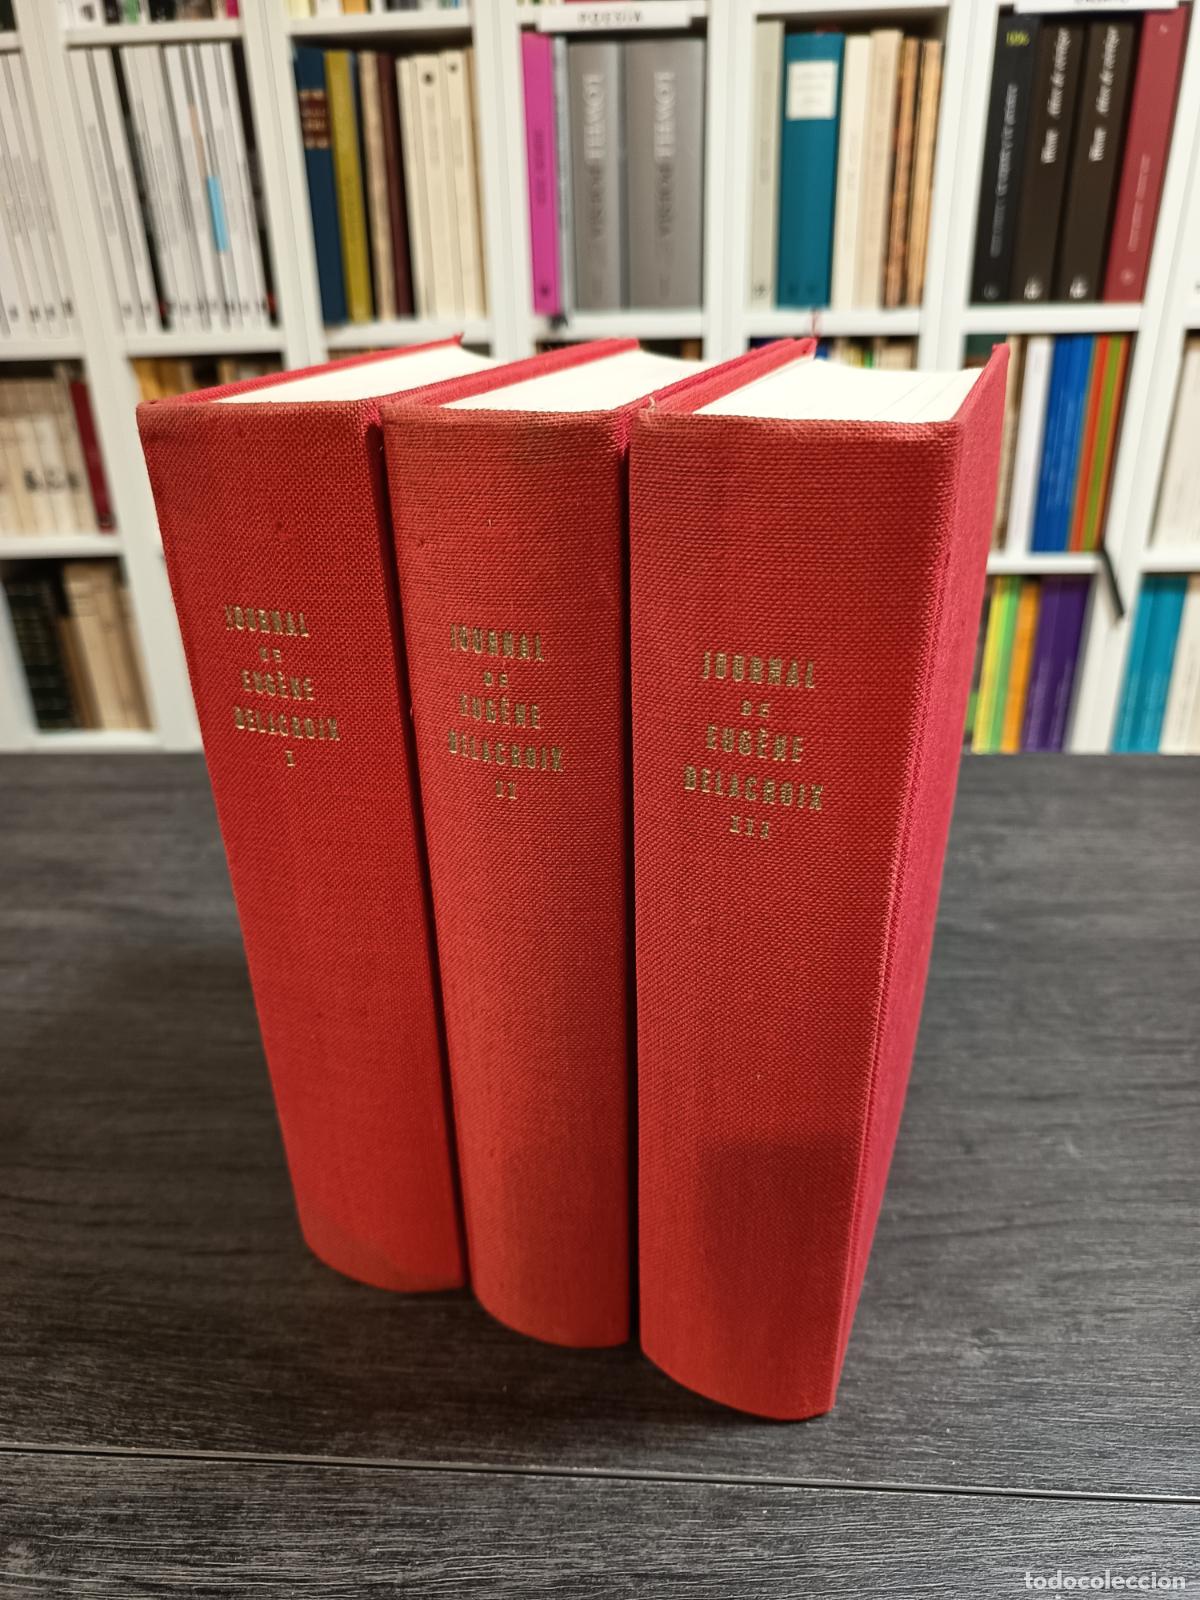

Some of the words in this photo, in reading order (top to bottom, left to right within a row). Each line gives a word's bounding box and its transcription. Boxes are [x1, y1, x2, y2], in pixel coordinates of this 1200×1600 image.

[225, 604, 309, 637] JOURNAL
[259, 646, 282, 663] DE
[450, 623, 545, 662] JOURNAL
[483, 671, 508, 687] DE
[703, 651, 815, 689] JOURNAL
[233, 705, 340, 741] DELACROIX
[740, 700, 770, 717] DE
[448, 729, 564, 772] DELACROIX
[683, 764, 824, 810] DELACROIX
